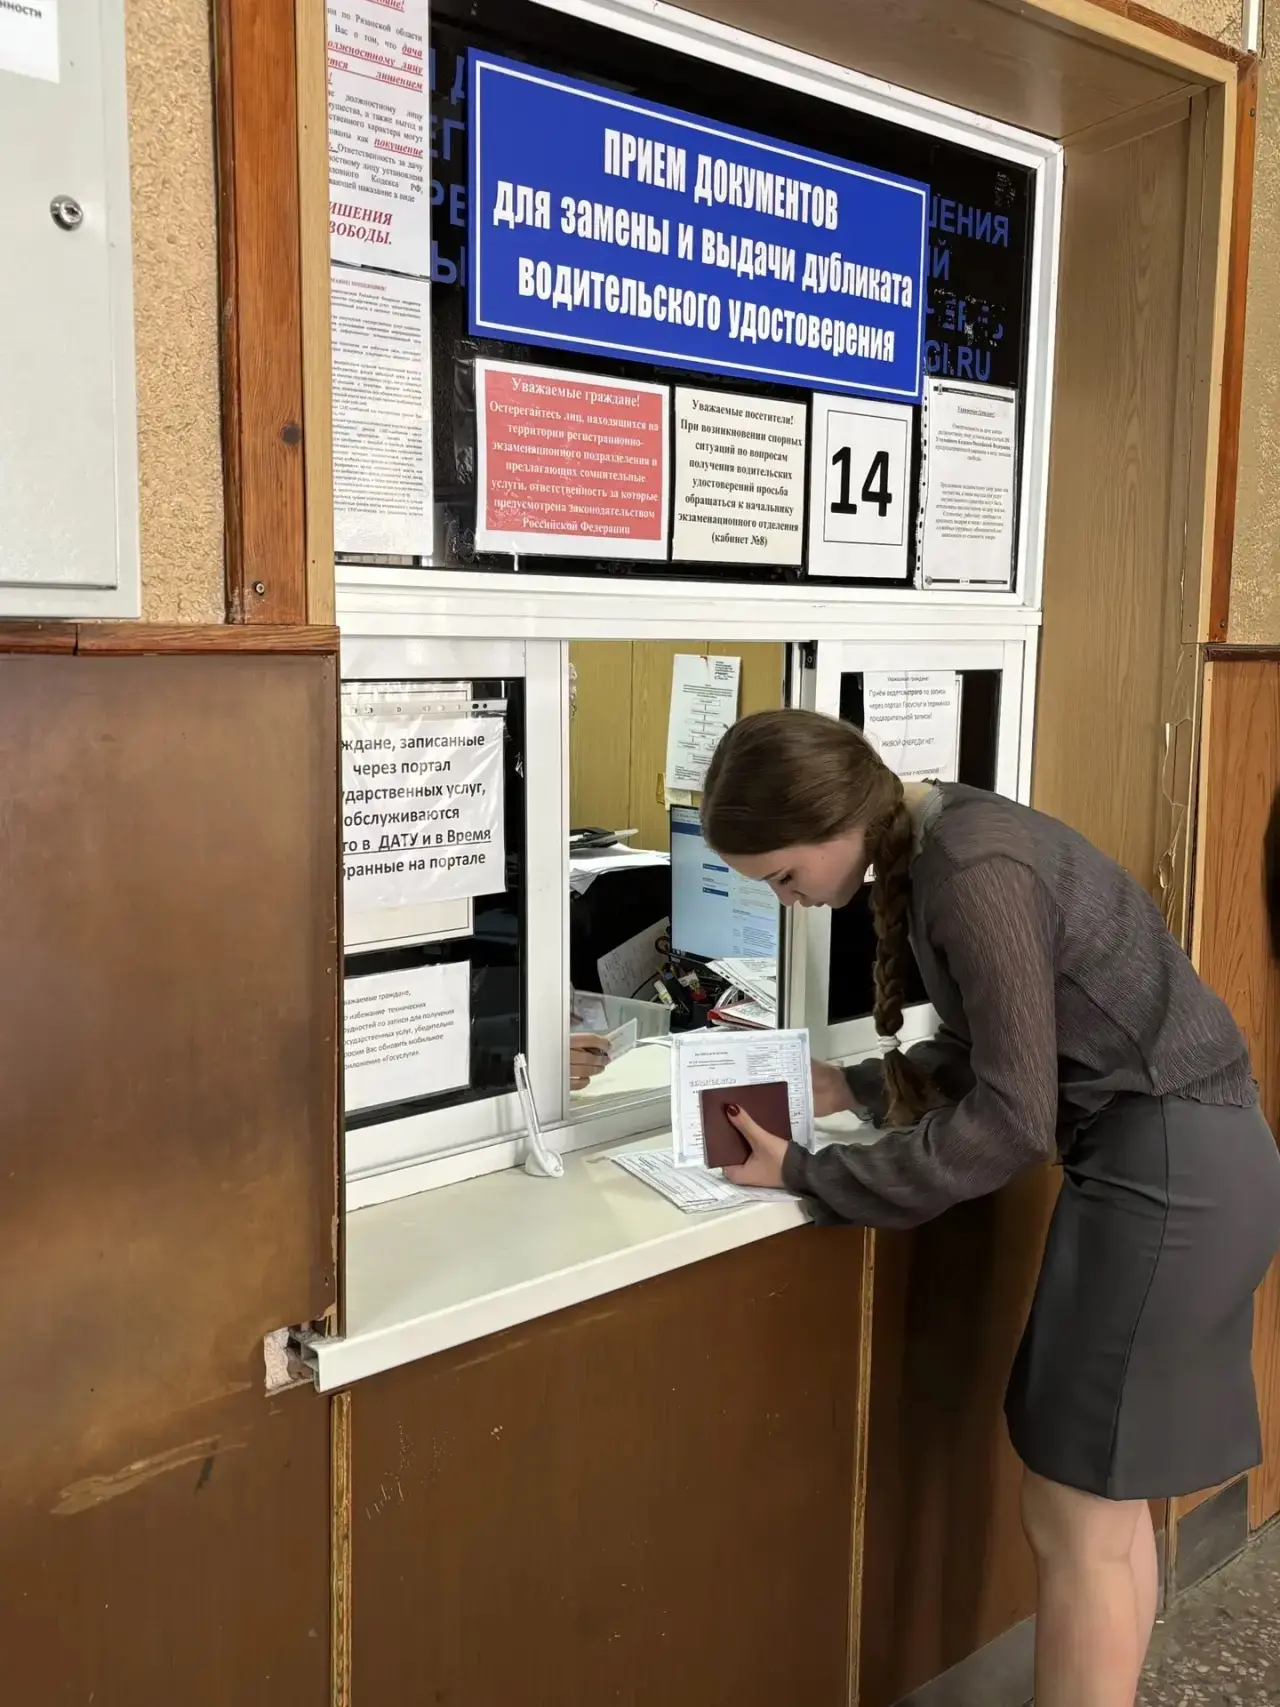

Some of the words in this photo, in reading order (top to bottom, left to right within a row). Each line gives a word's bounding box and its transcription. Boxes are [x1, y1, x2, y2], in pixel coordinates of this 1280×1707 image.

[356, 14, 391, 32] Рязанской
[396, 28, 422, 42] области
[335, 24, 348, 36] Вас
[364, 35, 380, 46] том,
[384, 41, 397, 50] что
[401, 43, 423, 58] дача
[400, 62, 423, 75] лицу
[375, 72, 423, 90] лишением
[345, 94, 396, 115] должностному
[407, 110, 423, 122] лицу
[372, 114, 392, 124] также
[396, 120, 416, 131] выгод
[368, 124, 401, 138] характера
[404, 132, 423, 144] могут
[357, 135, 368, 143] как
[374, 138, 423, 156] покушение
[338, 143, 396, 164] Ответственность
[408, 162, 423, 172] дачу
[362, 164, 380, 173] лицу
[382, 167, 423, 182] установлена
[604, 128, 686, 193] ПРИЕМ
[694, 154, 838, 230] ДОКУМЕНТОВ
[358, 184, 392, 198] наказание
[400, 194, 415, 203] виде
[371, 174, 399, 188] Кодекса
[410, 183, 423, 194] РФ,
[493, 180, 550, 230] для
[560, 196, 669, 256] замены
[678, 222, 694, 261] и
[702, 228, 796, 282] выдачи
[802, 252, 913, 308] дубликата
[518, 256, 721, 331] водительского
[728, 298, 895, 362] удостоверения
[511, 377, 582, 400] Уважаемые
[585, 391, 640, 408] граждане!
[490, 400, 561, 420] Остерегайтесь
[564, 411, 584, 424] лиц,
[587, 415, 646, 430] находящихся
[649, 422, 659, 431] на
[692, 399, 743, 417] Уважаемые
[745, 410, 794, 425] посетители!
[508, 424, 565, 440] территории
[568, 431, 644, 447] регистрационно-
[680, 418, 698, 433] При
[701, 424, 766, 440] возникновении
[768, 434, 802, 446] спорных
[492, 442, 581, 460] экзаменационного
[584, 451, 650, 466] подразделения
[652, 458, 658, 466] и
[695, 442, 735, 454] ситуаций
[737, 447, 748, 456] по
[750, 449, 788, 462] вопросам
[581, 468, 646, 483] сомнительные
[689, 459, 734, 472] получения
[737, 465, 792, 480] водительских
[491, 479, 527, 492] услуги,
[530, 484, 607, 498] ответственность
[610, 490, 619, 498] за
[621, 491, 658, 502] которые
[692, 477, 754, 493] удостоверений
[756, 485, 789, 497] просьба
[830, 446, 892, 517] 14
[494, 498, 566, 512] предусмотрена
[568, 504, 655, 518] законодательством
[685, 493, 736, 508] обращаться
[738, 501, 744, 509] к
[746, 502, 794, 516] начальнику
[522, 516, 578, 530] Российской
[580, 522, 630, 534] Федерации
[678, 513, 756, 527] экзаменационного
[759, 523, 799, 532] отделения
[712, 532, 748, 545] (кабинет
[750, 534, 768, 547] №8)
[341, 738, 395, 753] ждане,
[400, 735, 485, 749] записанные
[353, 762, 396, 778] через
[401, 760, 451, 775] портал
[446, 783, 486, 798] услуг,
[344, 808, 459, 827] обслуживаются
[362, 839, 370, 850] в
[378, 833, 418, 851] ДАТУ
[422, 834, 431, 844] и
[436, 833, 443, 844] в
[448, 829, 491, 845] Время
[408, 859, 425, 870] на
[430, 853, 486, 870] портале
[378, 990, 411, 1000] граждане,
[349, 1009, 385, 1019] избежание
[388, 1002, 426, 1013] технических
[388, 1016, 408, 1026] записи
[410, 1014, 421, 1022] для
[423, 1009, 454, 1019] получения
[414, 1020, 454, 1033] убедительно
[366, 1046, 377, 1054] Вас
[379, 1042, 407, 1051] обновить
[408, 1034, 444, 1045] мобильное
